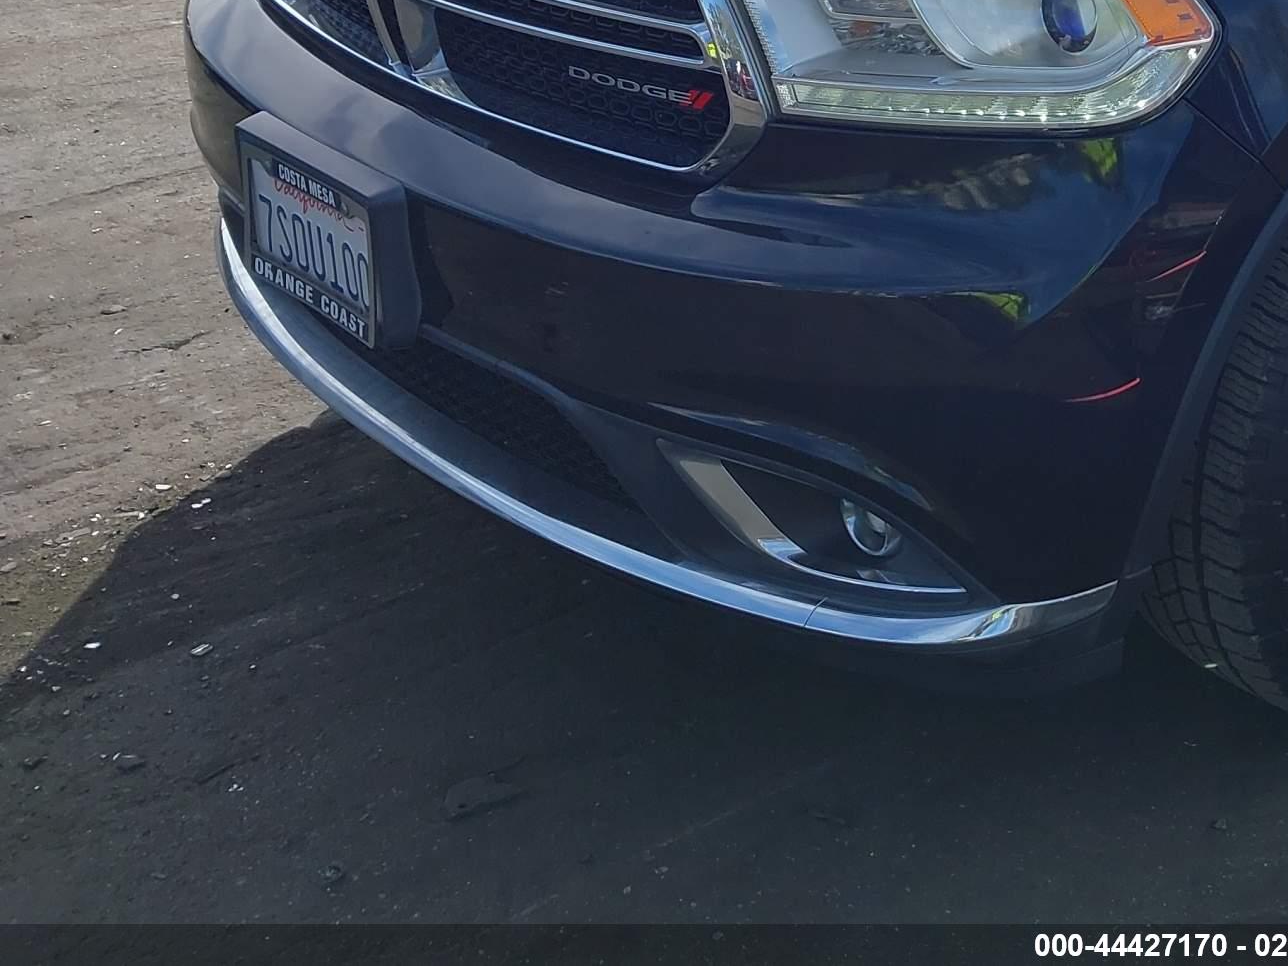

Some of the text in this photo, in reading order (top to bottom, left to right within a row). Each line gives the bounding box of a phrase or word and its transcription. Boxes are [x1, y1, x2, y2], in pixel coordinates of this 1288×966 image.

[568, 65, 693, 105] DODGE
[278, 163, 337, 207] COSTA MESA
[258, 193, 369, 308] 7SOU100
[254, 256, 367, 339] ORANGE COAST
